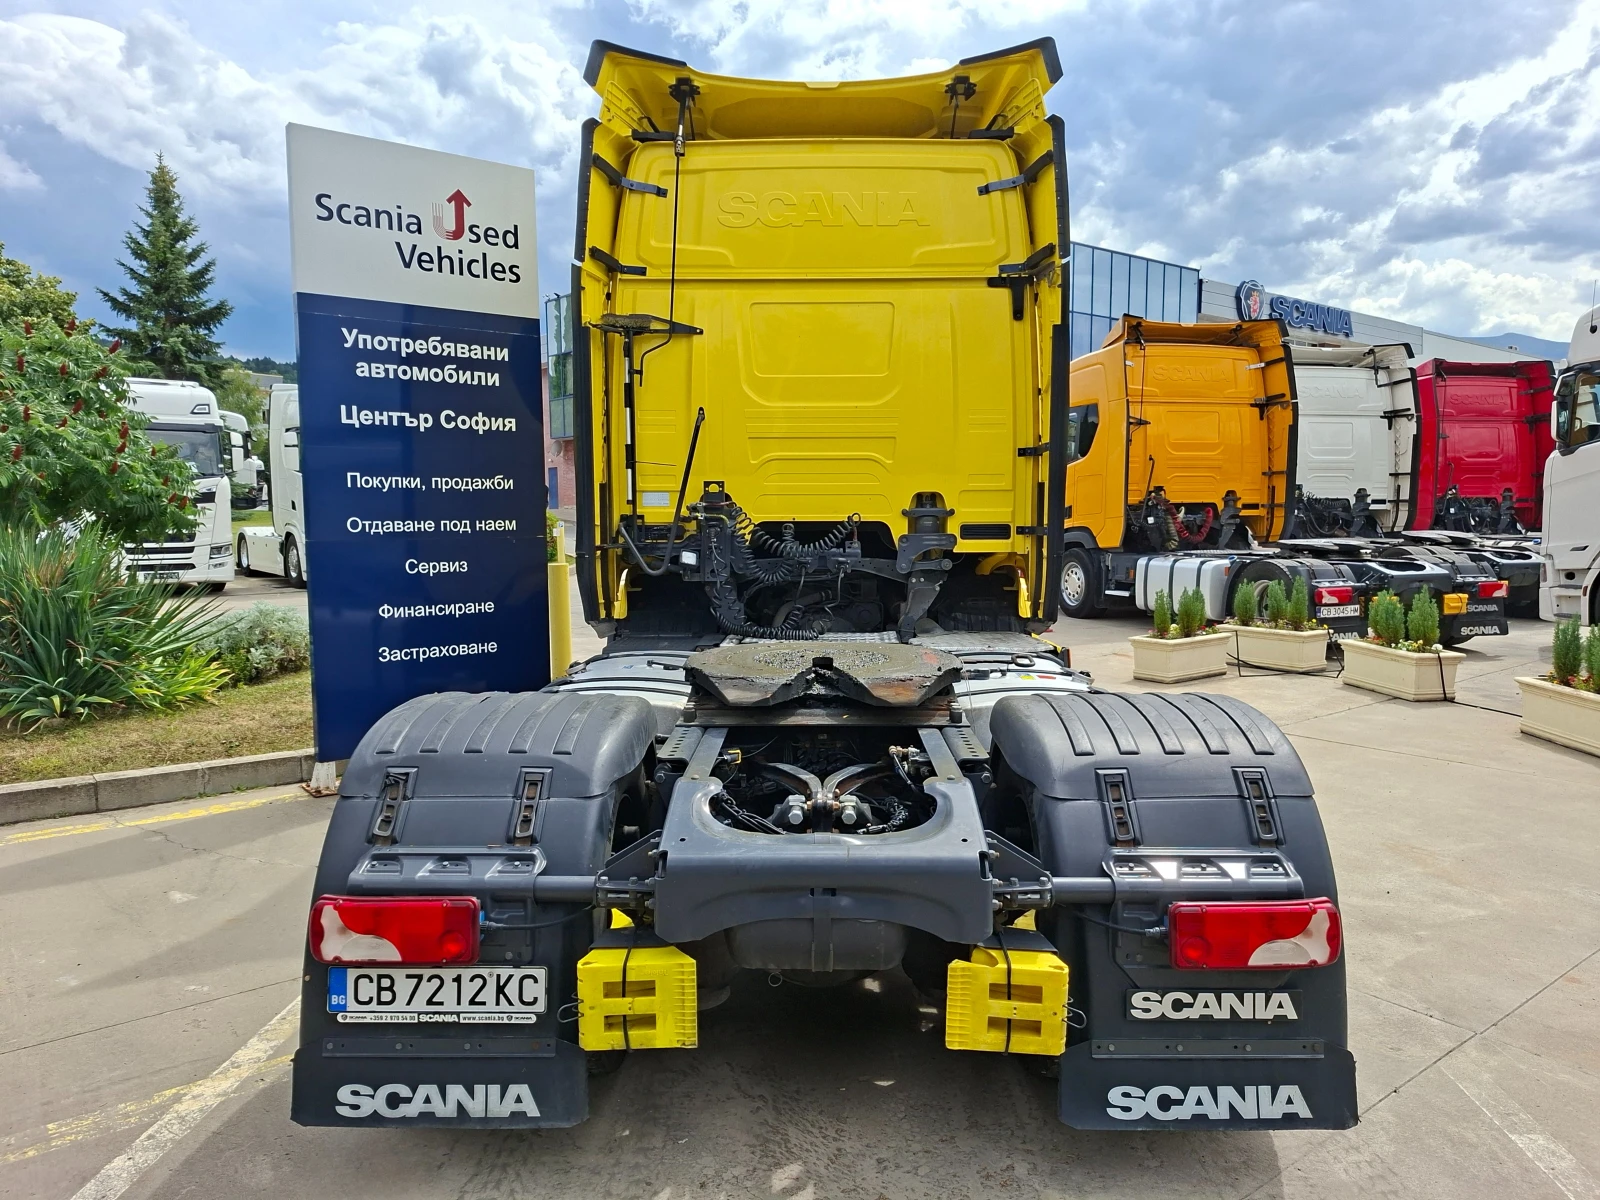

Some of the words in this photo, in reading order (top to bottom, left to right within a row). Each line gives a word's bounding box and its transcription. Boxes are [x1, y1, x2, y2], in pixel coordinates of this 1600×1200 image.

[315, 193, 422, 235] Scania
[431, 189, 520, 250] Used
[717, 191, 930, 228] SCANIA
[394, 241, 521, 284] Vehicles
[1271, 296, 1354, 337] SCANIA
[341, 327, 509, 361] Употребявани
[355, 360, 500, 386] автомобили
[1153, 365, 1231, 382] SCANIA
[1450, 393, 1508, 406] SCANIA
[340, 405, 433, 432] Център
[440, 410, 517, 434] София
[346, 472, 426, 492] Покупки,
[432, 475, 514, 491] продажби
[346, 517, 435, 535] Отдаване
[440, 520, 471, 534] под
[476, 517, 517, 531] наем
[405, 558, 468, 576] Сервиз
[378, 601, 495, 619] Финансиране
[1321, 607, 1332, 616] CB
[1333, 607, 1349, 616] 3045
[1467, 604, 1499, 612] SCANIA
[1330, 632, 1360, 642] ANIA
[1460, 626, 1500, 636] SCANIA
[378, 640, 498, 662] Застраховане
[331, 994, 346, 1005] BG
[353, 974, 397, 1006] CB
[405, 974, 488, 1006] 7212
[495, 974, 539, 1006] KC
[1130, 991, 1299, 1020] SCANIA
[419, 1013, 459, 1023] SCANIA
[462, 1014, 505, 1022] www.scania.bg
[335, 1083, 541, 1118] SCANIA
[1106, 1084, 1313, 1121] SCANIA
